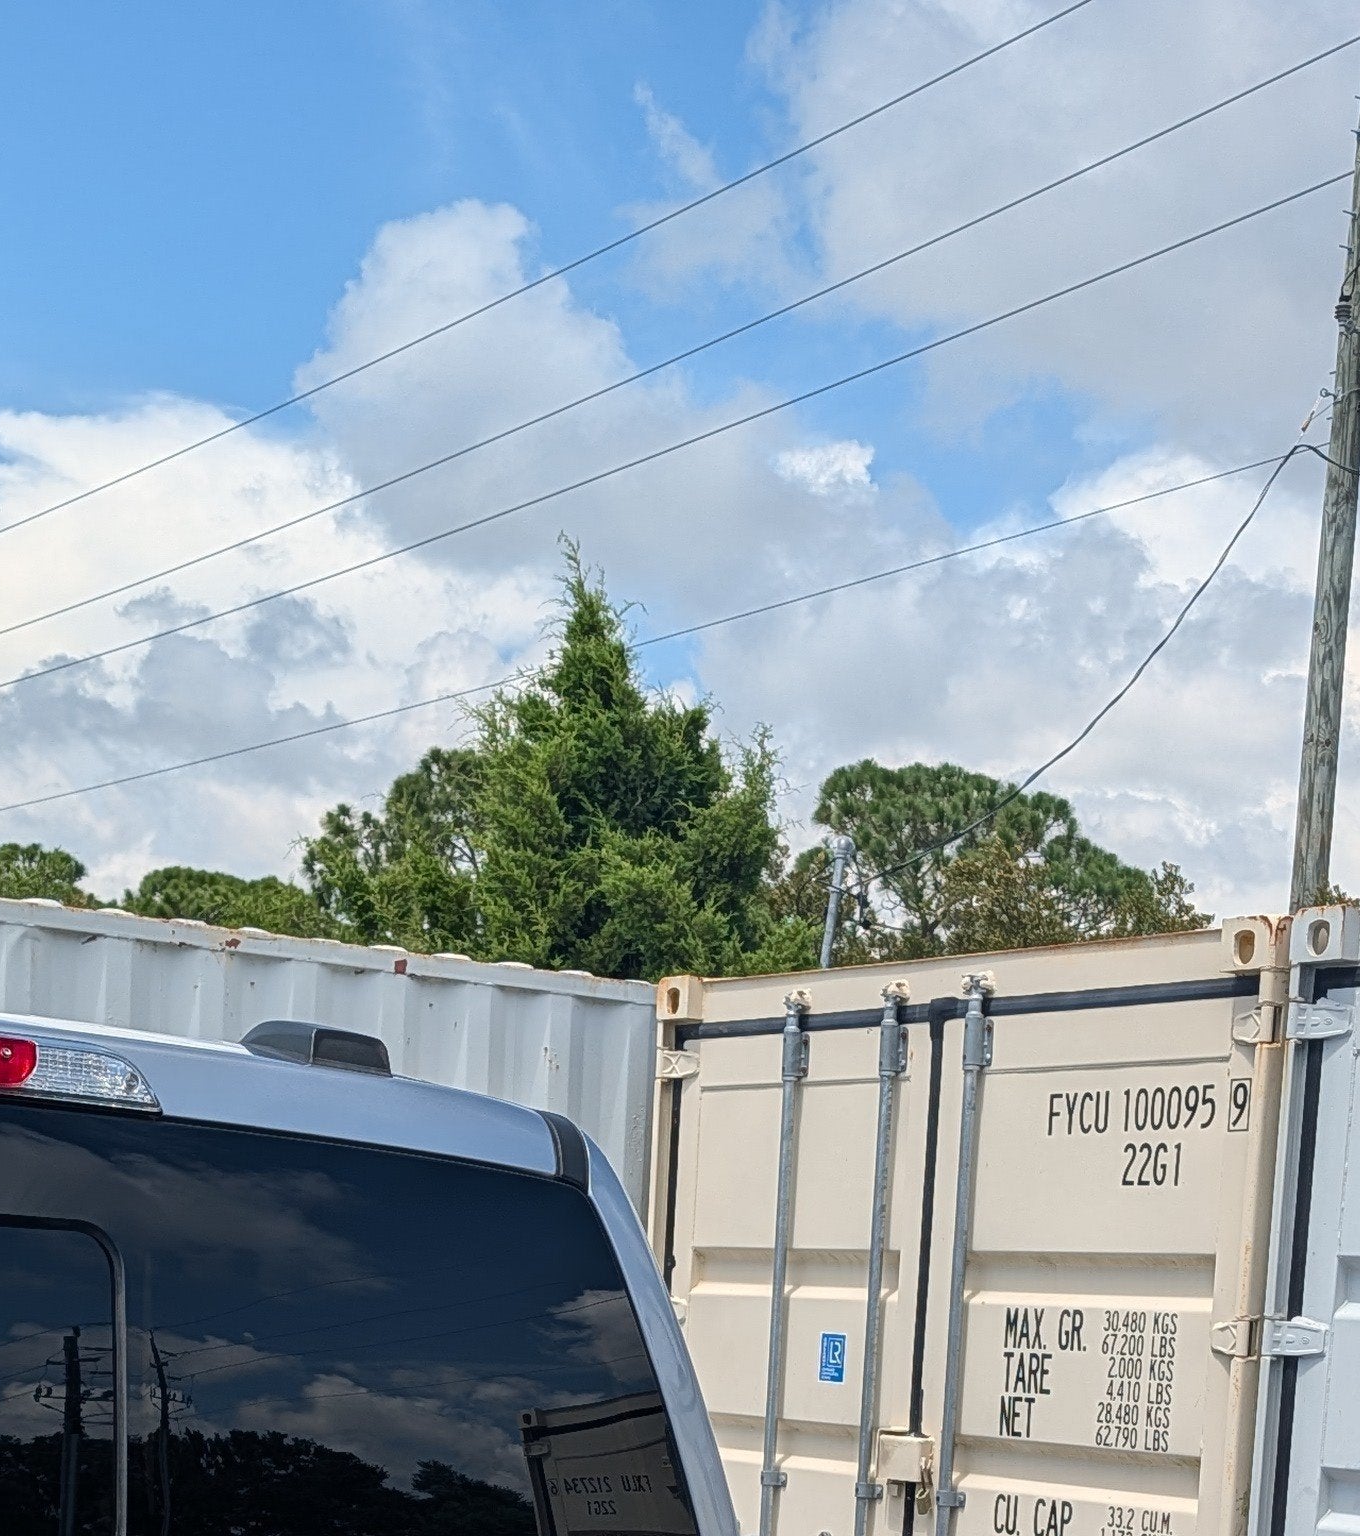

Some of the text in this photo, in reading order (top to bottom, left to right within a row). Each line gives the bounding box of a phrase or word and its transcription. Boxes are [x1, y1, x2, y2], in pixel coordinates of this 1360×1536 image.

[1048, 1082, 1248, 1136] FYCU 100095 9
[1122, 1142, 1182, 1186] 22G1
[1004, 1307, 1046, 1350] MAX.
[1058, 1308, 1087, 1352] GR.
[1152, 1312, 1178, 1334] KGS
[1150, 1336, 1176, 1358] LBS
[1003, 1352, 1052, 1395] TARE
[1148, 1359, 1175, 1382] KGS
[1147, 1382, 1172, 1406] LBS
[998, 1395, 1036, 1438] NET
[1145, 1406, 1170, 1429] KGS
[1144, 1428, 1170, 1452] LBS
[994, 1494, 1020, 1536] CU.
[1106, 1506, 1135, 1530] 33.2
[1140, 1510, 1174, 1536] CU.M.
